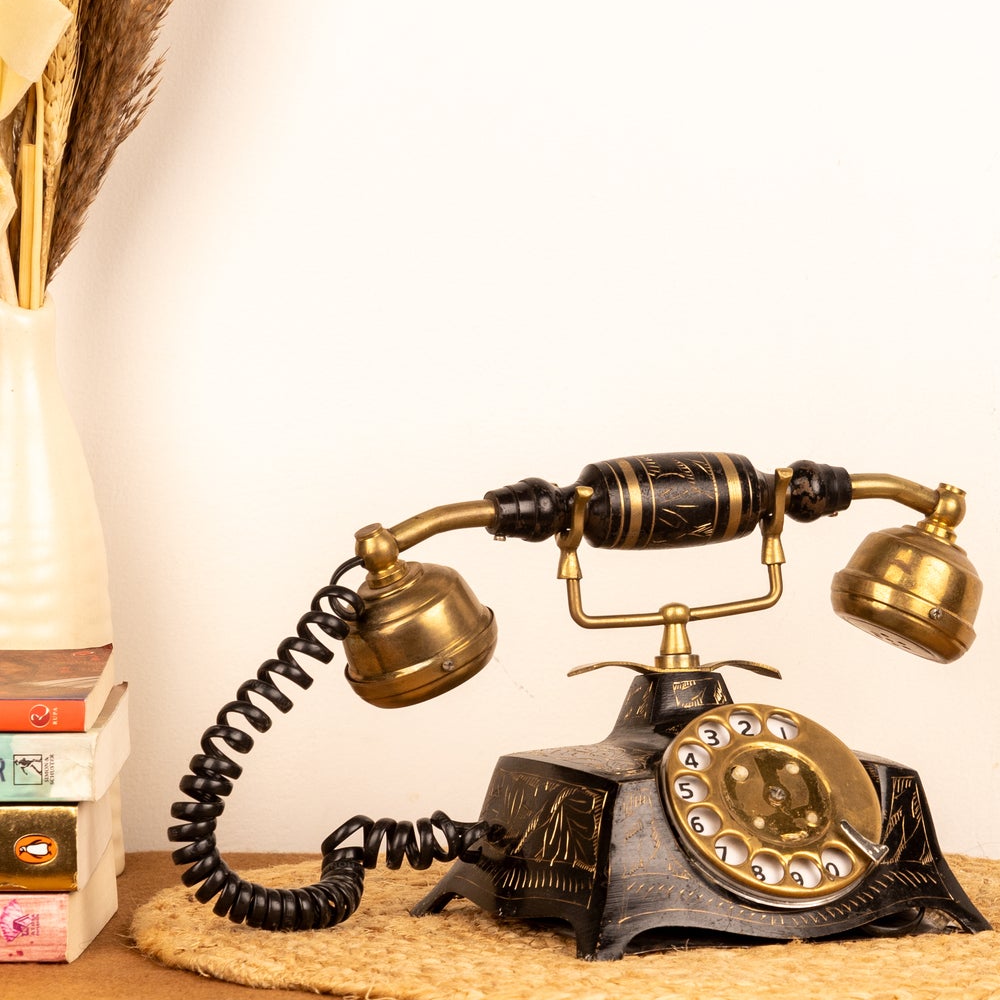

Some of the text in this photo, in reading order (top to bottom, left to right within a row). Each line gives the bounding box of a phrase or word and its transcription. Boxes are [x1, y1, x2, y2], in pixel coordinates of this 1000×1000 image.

[678, 720, 840, 886] 1 2 3 4 5 6 7 8 9 0
